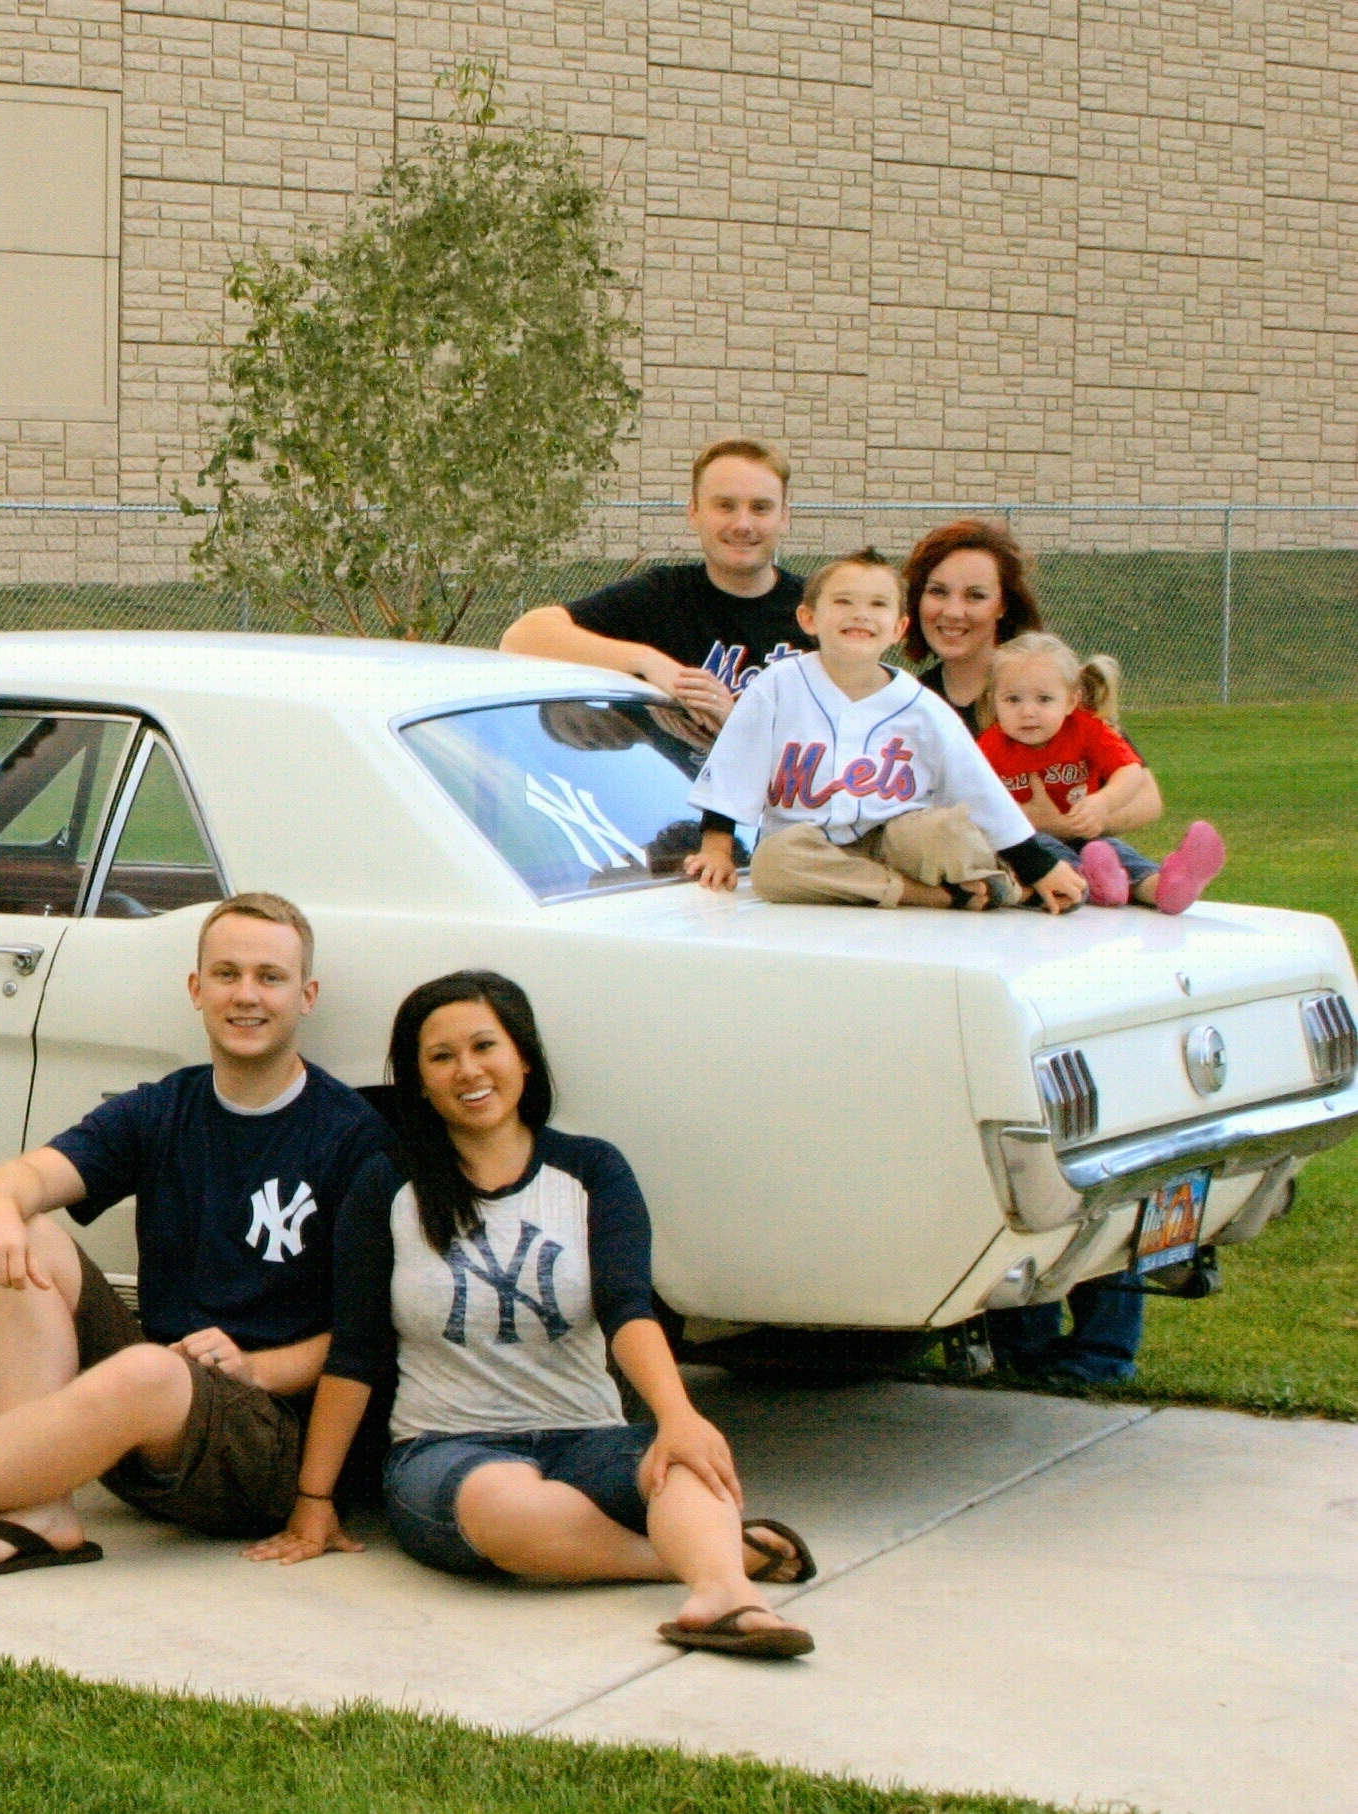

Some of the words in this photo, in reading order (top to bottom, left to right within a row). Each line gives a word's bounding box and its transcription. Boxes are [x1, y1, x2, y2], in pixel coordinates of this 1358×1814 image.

[768, 737, 917, 809] Mets
[525, 771, 647, 873] NY
[245, 1178, 318, 1263] NY
[442, 1221, 573, 1347] NY
